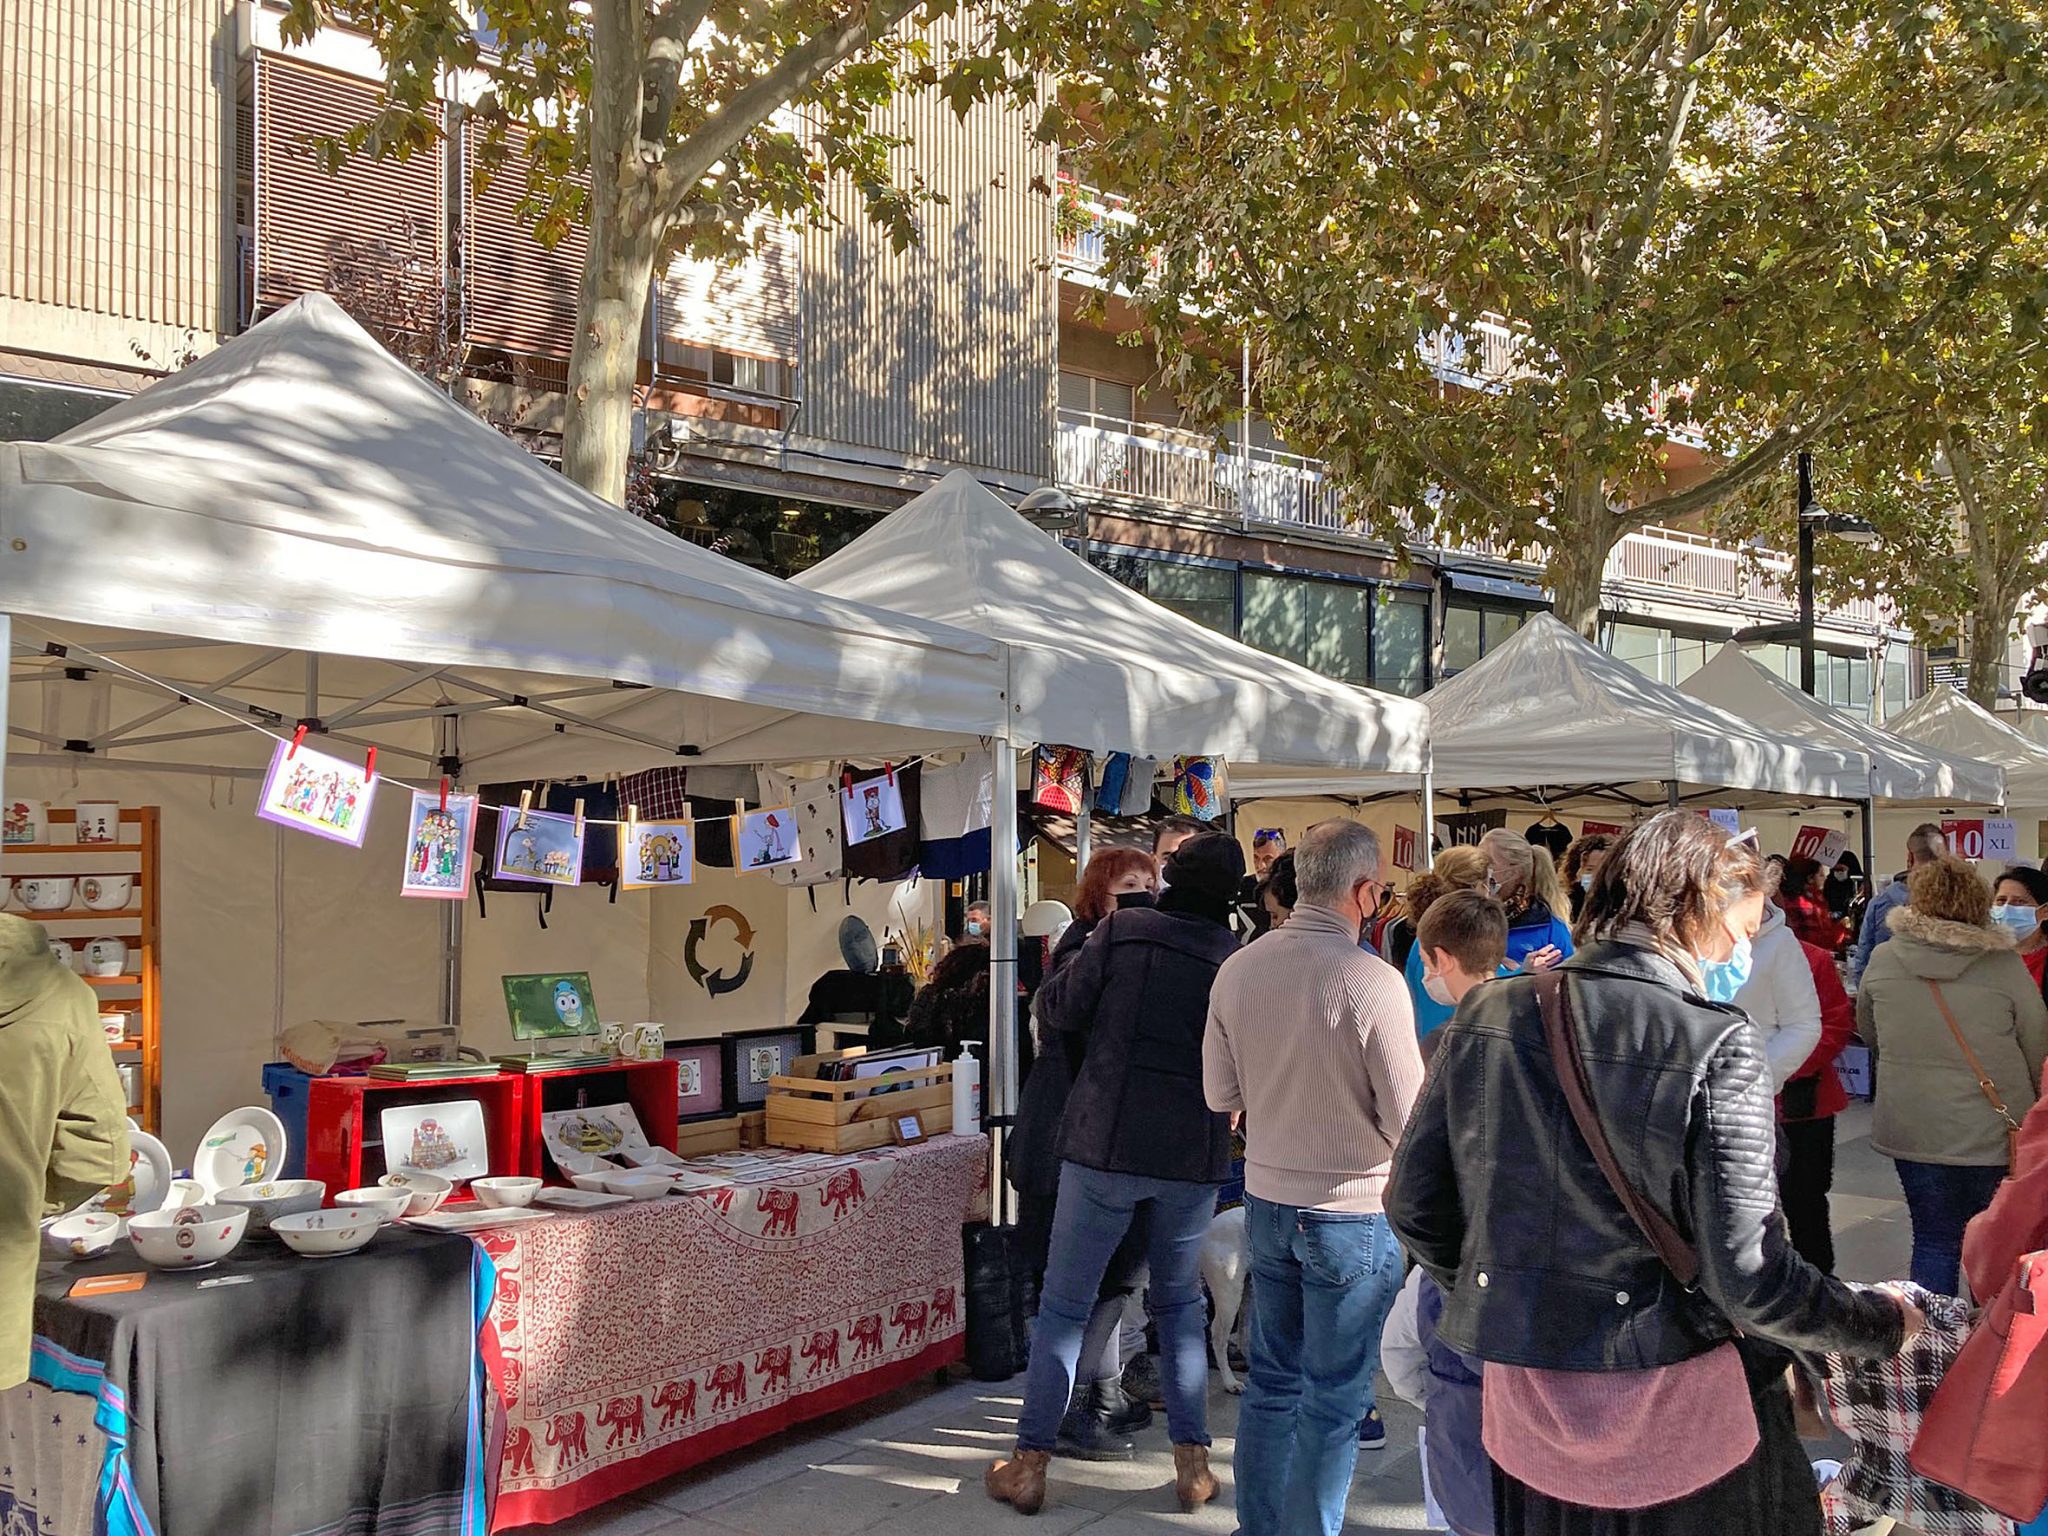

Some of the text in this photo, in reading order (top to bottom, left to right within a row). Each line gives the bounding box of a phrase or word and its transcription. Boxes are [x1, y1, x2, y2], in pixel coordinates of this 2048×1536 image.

[1395, 837, 1412, 869] 10
[1795, 835, 1820, 859] 10
[1818, 846, 1837, 860] XL
[1944, 829, 1983, 858] 10
[1988, 838, 2010, 850] XL
